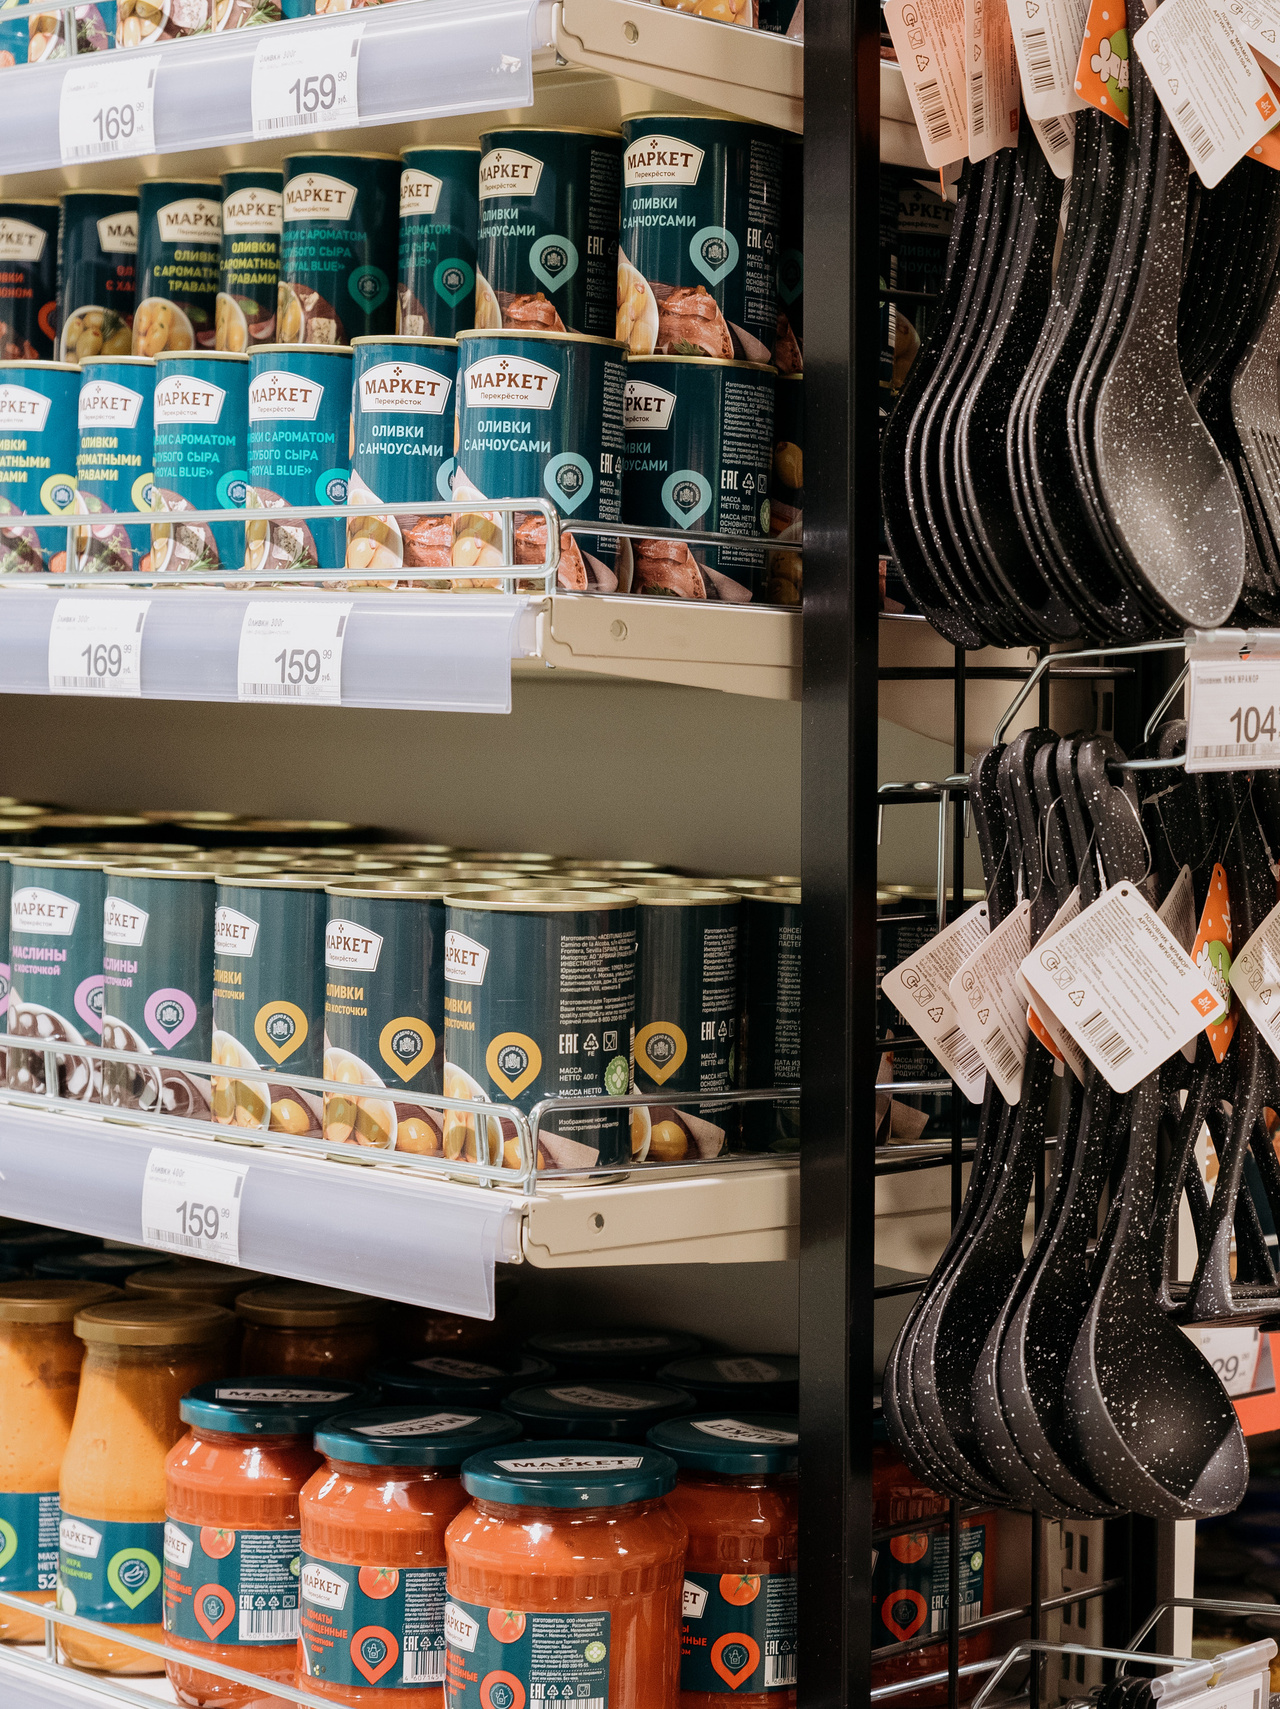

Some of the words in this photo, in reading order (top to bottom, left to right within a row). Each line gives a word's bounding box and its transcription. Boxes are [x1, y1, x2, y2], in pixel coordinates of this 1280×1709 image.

[288, 73, 337, 114] 159
[337, 71, 348, 82] 99
[92, 104, 135, 141] 169
[135, 102, 145, 112] 99
[627, 151, 694, 171] МАРКЕТ
[480, 164, 533, 182] МАРКЕТ
[634, 171, 676, 179] Перекрёсток
[400, 184, 433, 198] АРКЕТ
[485, 183, 518, 191] Перекрёсток
[286, 188, 347, 205] МАРКЕТ
[632, 197, 678, 210] ОЛИВКИ
[482, 208, 519, 222] ОЛИВКИ
[627, 215, 697, 228] АНЧОУСАМИ
[306, 229, 367, 242] АРОМАТОМ
[480, 225, 536, 240] АНЧОУСАМИ
[231, 241, 276, 254] ОЛИВКИ
[319, 246, 353, 258] СЫРА
[227, 273, 277, 285] ТРАВАМИ
[365, 378, 441, 397] МАРКЕТ
[470, 373, 549, 392] МАРКЕТ
[157, 391, 215, 408] МАРКЕТ
[251, 388, 313, 404] МАРКЕТ
[374, 398, 422, 406] Перекрёсток
[480, 392, 529, 401] Перекрёсток
[80, 396, 132, 412] МАРКЕТ
[624, 396, 666, 413] РКЕТ
[371, 425, 424, 439] ОЛИВКИ
[477, 421, 532, 435] ОЛИВКИ
[81, 436, 119, 449] ОЛИВКИ
[174, 434, 237, 447] АРОМАТОМ
[271, 431, 336, 444] АРОМАТОМ
[359, 443, 365, 454] С
[365, 442, 444, 458] АНЧОУСАМИ
[464, 439, 470, 451] С
[470, 439, 551, 454] АНЧОУСАМИ
[186, 451, 221, 464] СЫРА
[284, 449, 320, 462] СЫРА
[78, 469, 119, 482] ТРАВАМИ
[179, 466, 214, 478] BLUE»
[276, 464, 313, 477] BLUE»
[720, 495, 741, 503] МАССА
[741, 504, 751, 512] 300
[720, 513, 741, 521] МАССА
[720, 520, 753, 529] ОСНОВНОГО
[80, 643, 123, 677] 169
[122, 644, 133, 655] 99
[274, 648, 322, 685] 159
[322, 649, 333, 661] 99
[1229, 705, 1278, 744] 104
[14, 902, 68, 919] МАРКЕТ
[104, 911, 140, 930] АРКЕТ
[1143, 912, 1169, 944] ПОЛОВНИК
[12, 945, 68, 962] МАСЛИНЫ
[445, 946, 480, 967] АРКЕТ
[326, 982, 364, 1001] ОЛИВКИ
[700, 1052, 718, 1060] МАССА
[774, 1065, 795, 1073] НОМЕР
[559, 1074, 582, 1082] НЕТТО:
[700, 1072, 717, 1081] МАССА
[559, 1088, 582, 1096] МАССА
[583, 1087, 603, 1095] НЕТТО
[176, 1200, 220, 1240] 159
[220, 1207, 230, 1219] 99
[229, 1390, 337, 1400] МАРКЕТ
[511, 1458, 630, 1469] МАРКЕТ
[61, 1527, 95, 1546] МАРКЕТ
[303, 1573, 342, 1596] МАРКЕТ
[306, 1608, 333, 1625] ТОМАТЫ
